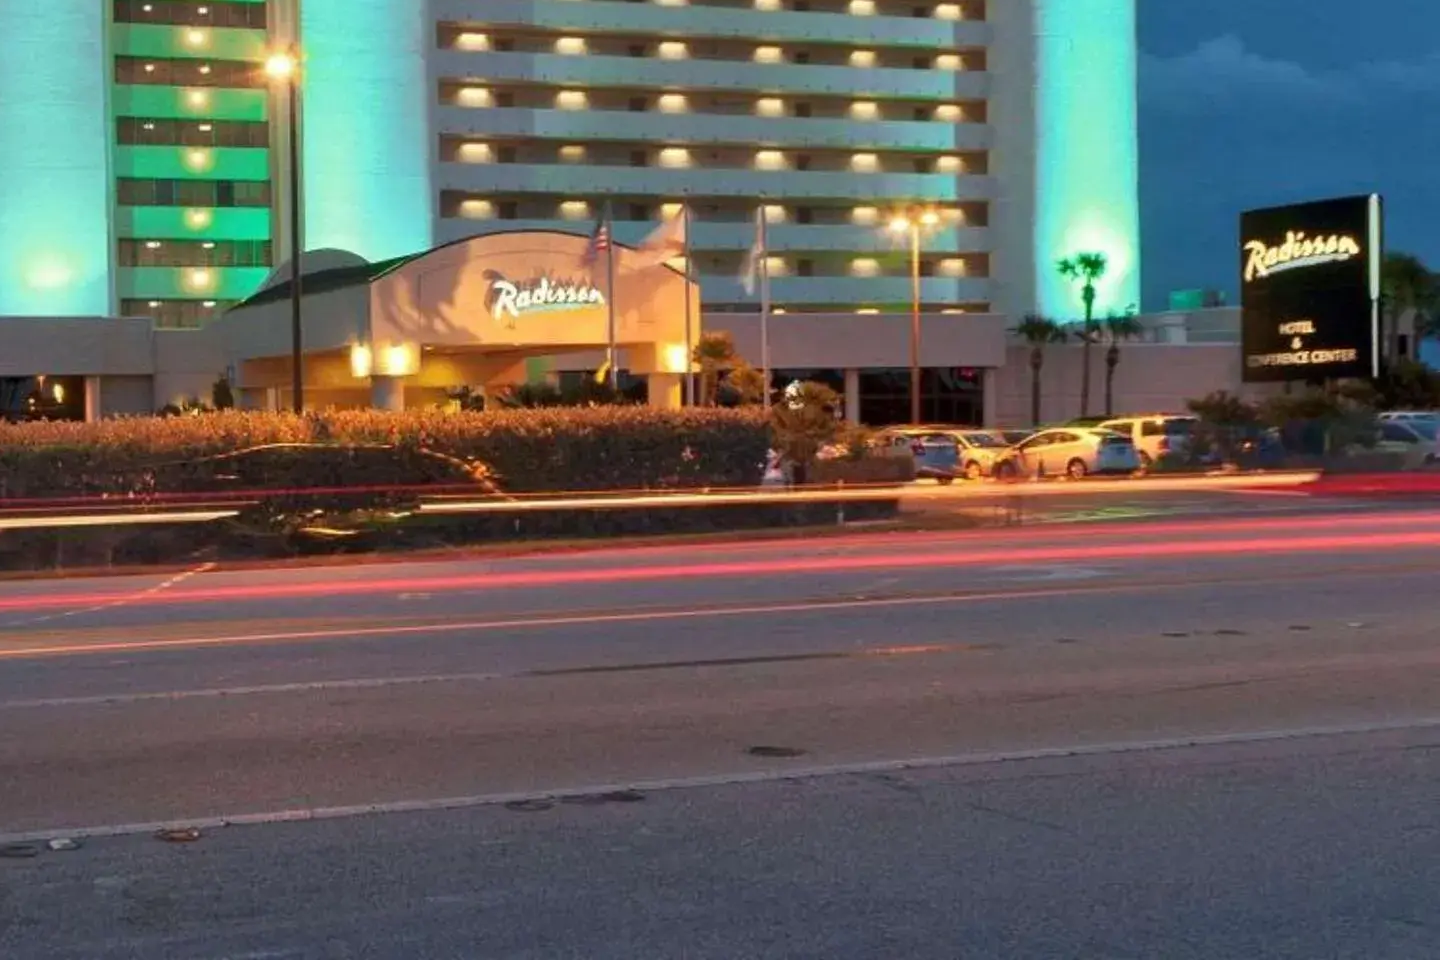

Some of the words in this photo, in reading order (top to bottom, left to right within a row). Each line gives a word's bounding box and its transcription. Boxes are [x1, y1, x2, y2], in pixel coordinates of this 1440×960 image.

[1244, 230, 1359, 282] Radisson
[493, 277, 605, 320] Radisson
[1311, 349, 1357, 364] CENTER
